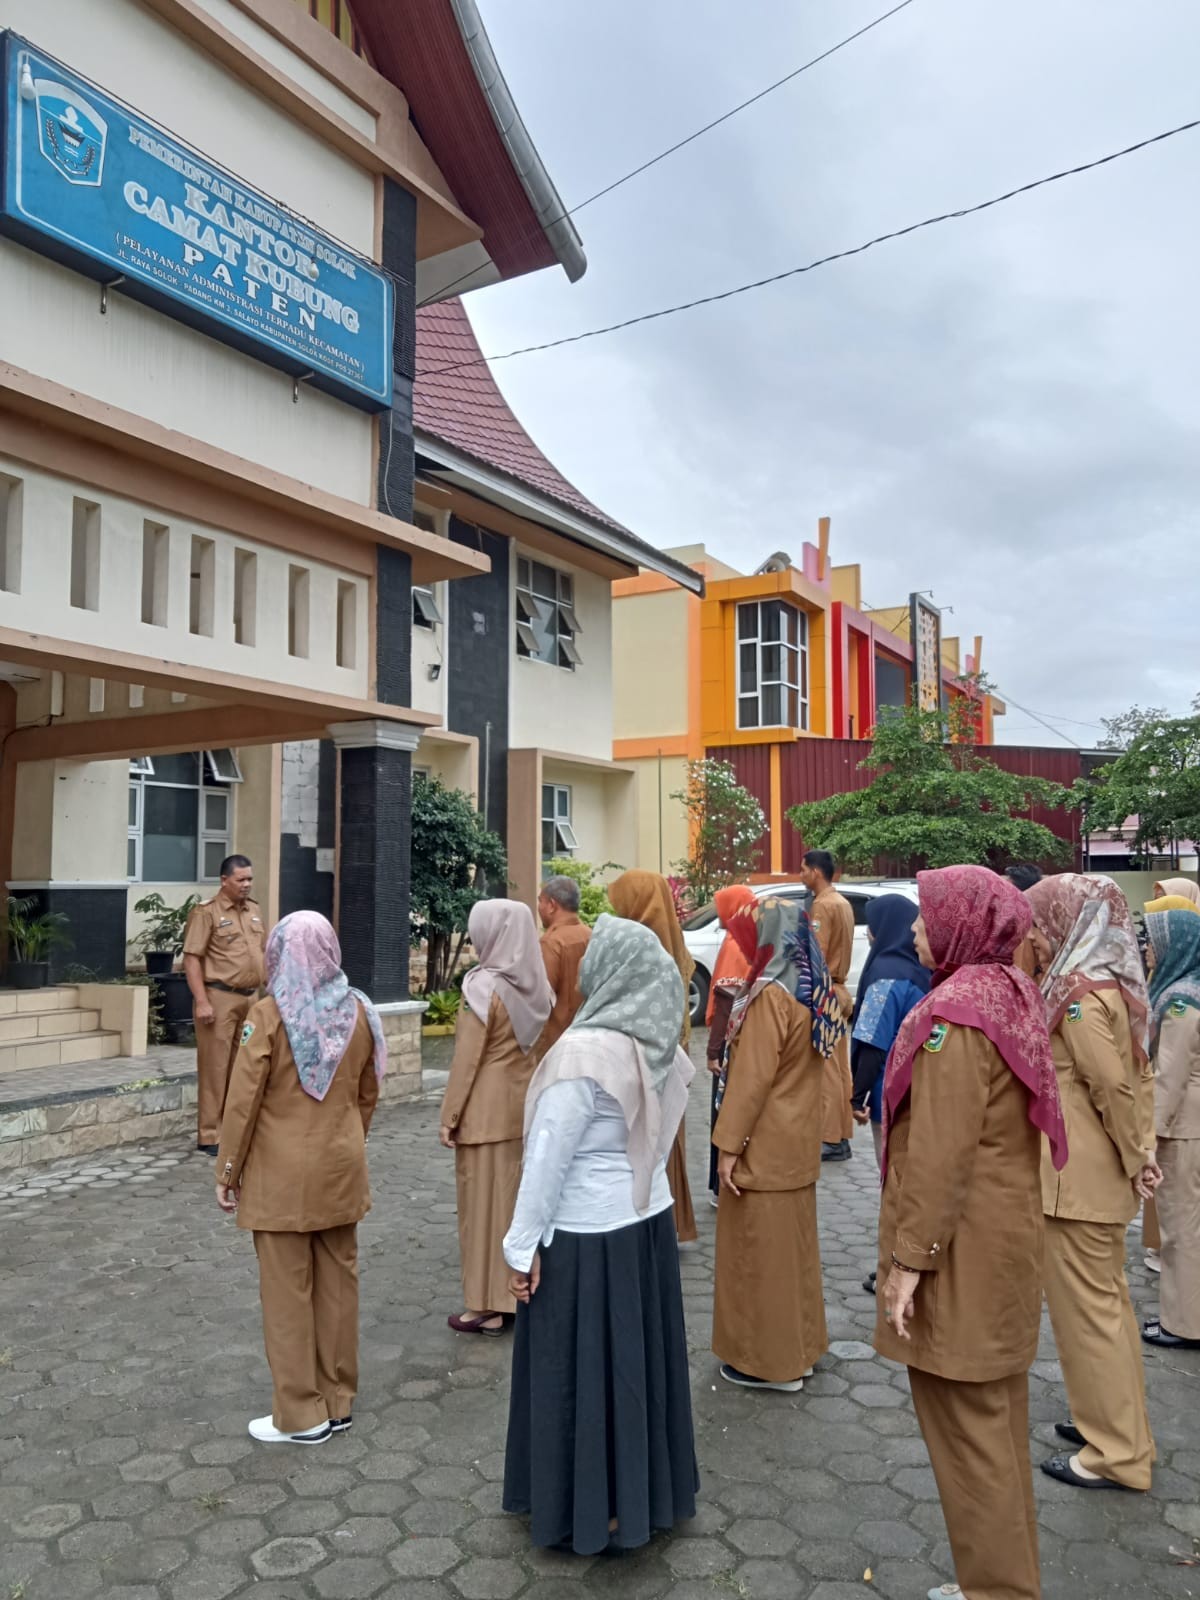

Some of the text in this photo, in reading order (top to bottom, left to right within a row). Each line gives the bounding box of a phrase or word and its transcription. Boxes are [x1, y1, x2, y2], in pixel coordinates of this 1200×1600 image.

[128, 125, 233, 205] PEMERINTAH
[316, 244, 357, 280] SOLOK
[184, 182, 317, 282] KANTOR
[123, 180, 360, 335] CAMAT KUBUNG
[131, 255, 151, 272] RAYA
[153, 267, 178, 286] SOLOK
[183, 283, 213, 303] PADANG
[191, 273, 263, 317] ADMINISTRASI
[265, 311, 307, 340] TERPADU
